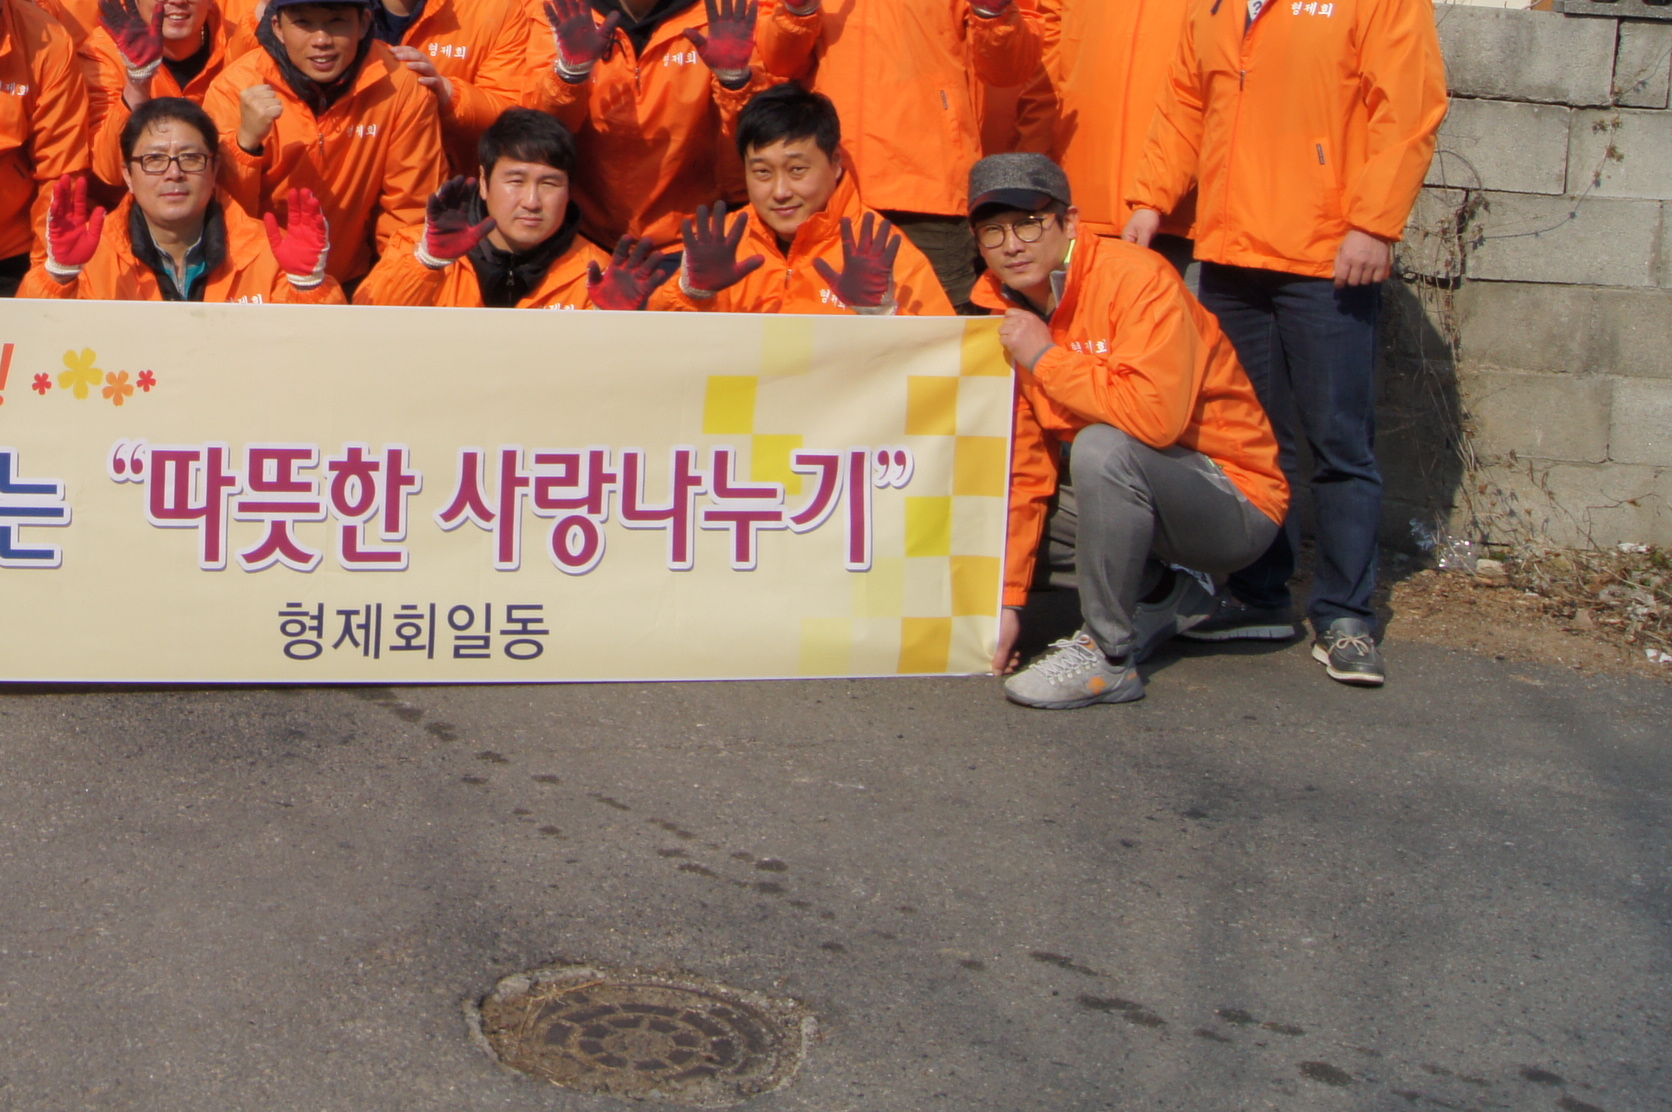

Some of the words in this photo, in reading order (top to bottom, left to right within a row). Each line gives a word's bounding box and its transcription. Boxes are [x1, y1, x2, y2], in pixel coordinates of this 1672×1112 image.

[1291, 1, 1333, 18] 형제회
[428, 42, 468, 60] 형제회
[662, 50, 698, 67] 형제회
[277, 600, 551, 661] 형제회일동
